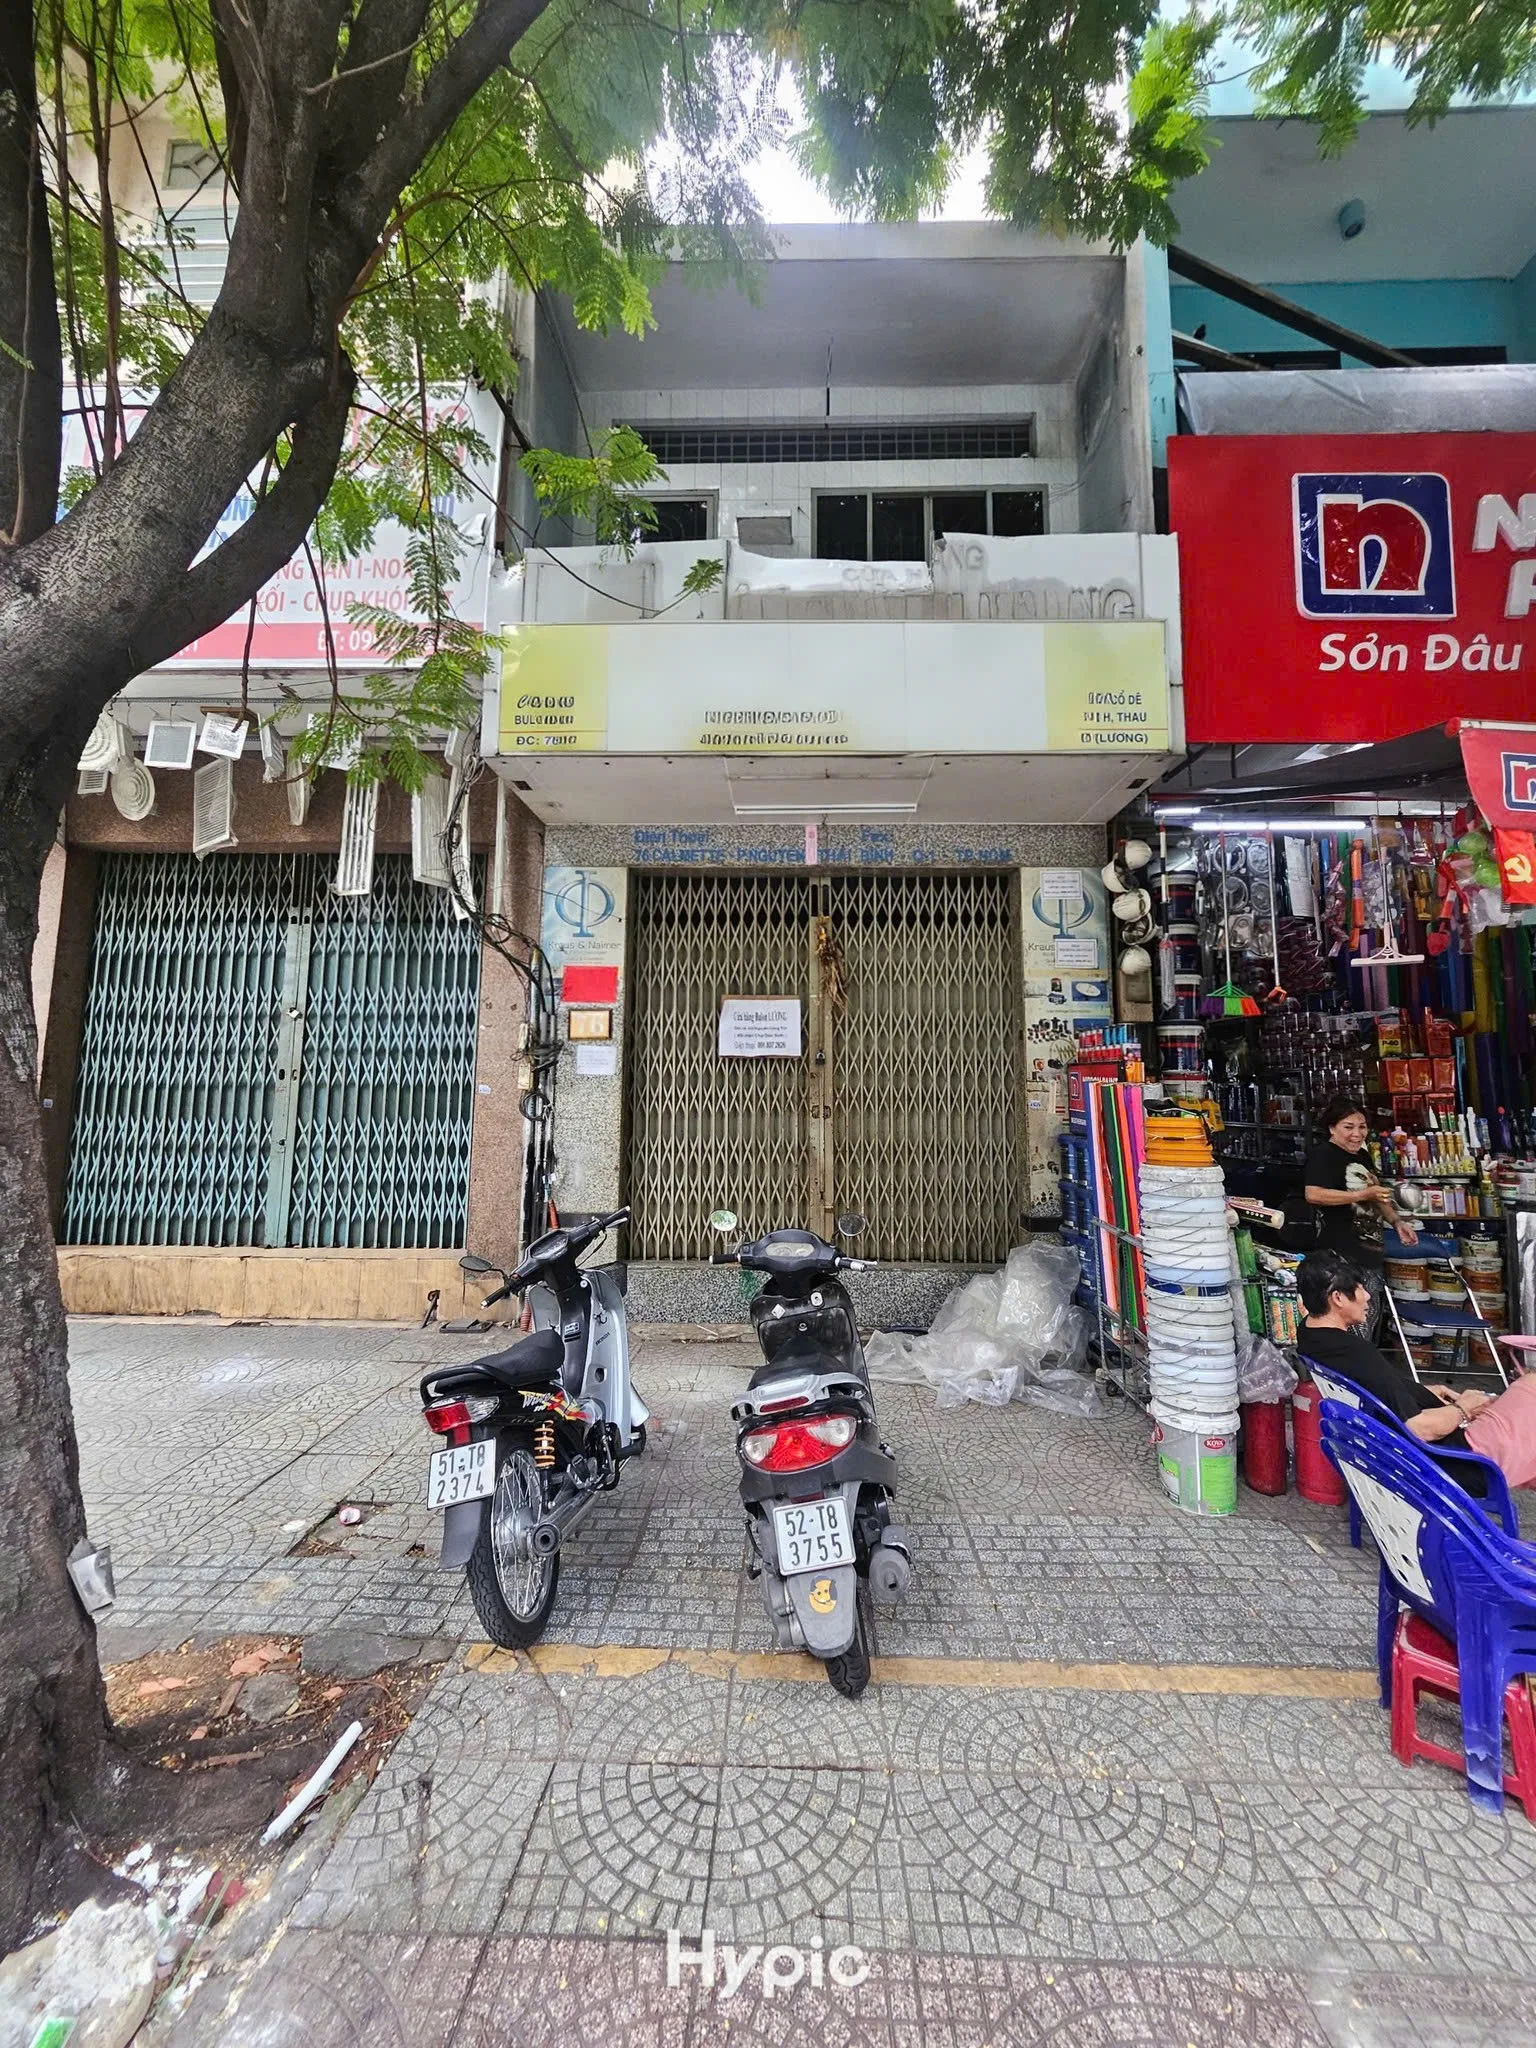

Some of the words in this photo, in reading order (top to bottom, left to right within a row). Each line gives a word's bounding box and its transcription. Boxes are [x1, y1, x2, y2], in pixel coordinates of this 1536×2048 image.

[1421, 633, 1523, 671] Đâu
[436, 1471, 484, 1504] 2374
[789, 1533, 843, 1566] 3755
